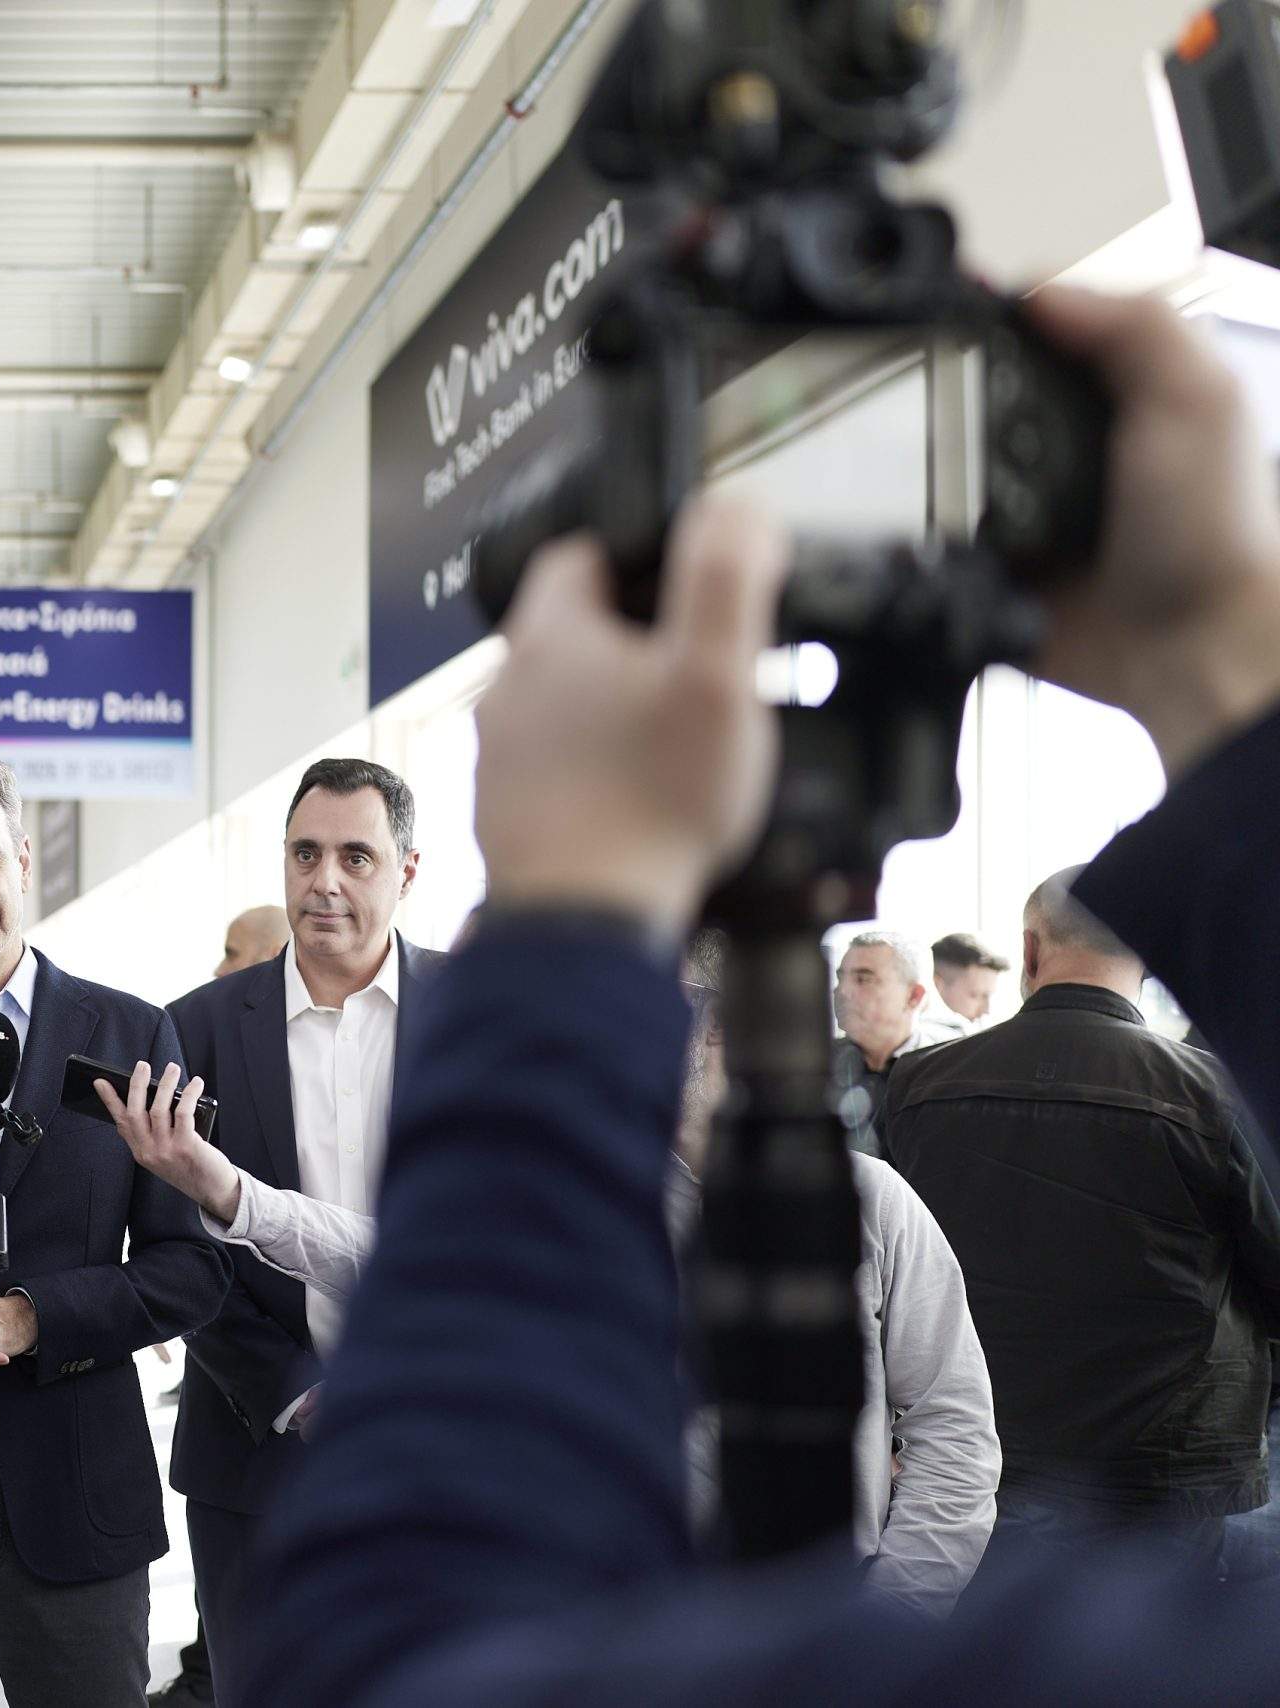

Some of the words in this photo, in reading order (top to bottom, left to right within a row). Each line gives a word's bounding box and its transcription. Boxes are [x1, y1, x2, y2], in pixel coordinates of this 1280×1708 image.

[470, 199, 623, 396] viva.com
[455, 424, 491, 479] Tech
[491, 382, 533, 449] Bank
[533, 370, 553, 409] in
[13, 690, 99, 730] Energy
[102, 691, 184, 723] Drinks
